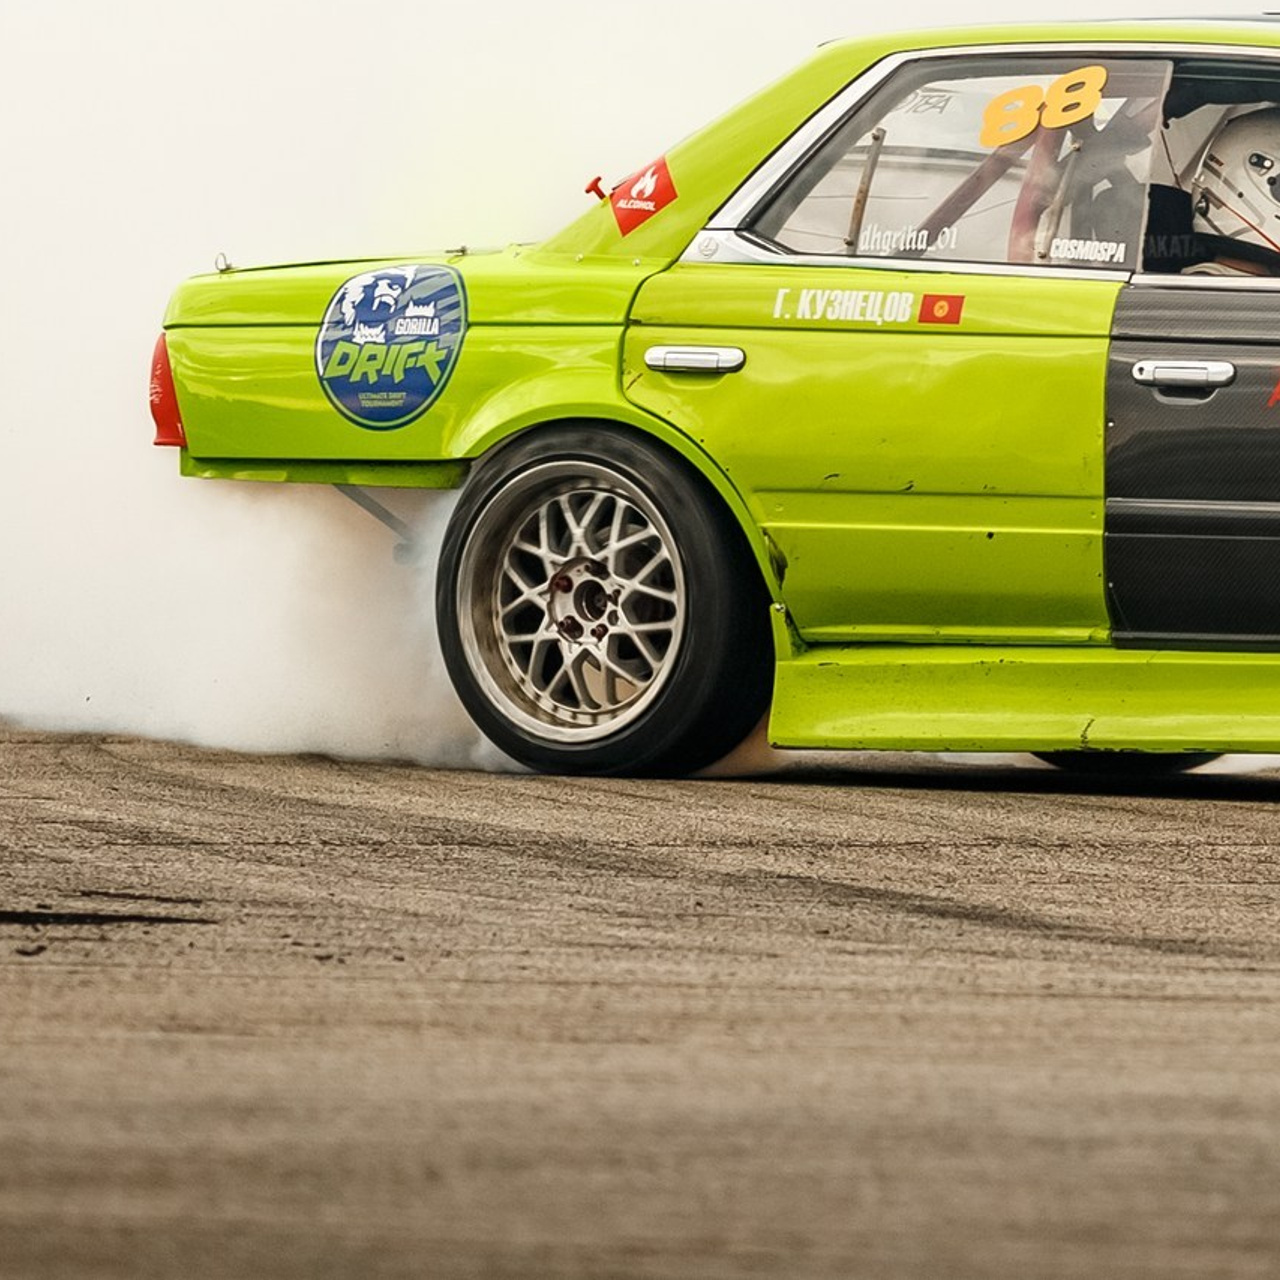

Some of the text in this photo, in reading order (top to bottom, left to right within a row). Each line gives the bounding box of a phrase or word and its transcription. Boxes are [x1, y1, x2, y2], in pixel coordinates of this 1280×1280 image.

[979, 65, 1108, 147] 88
[1050, 238, 1126, 263] COSMOSPA
[1146, 234, 1206, 258] AKATA
[773, 288, 914, 325] Г. КУЗНЕЦОВ
[395, 318, 440, 335] GORILLA
[323, 340, 449, 386] DRIFT
